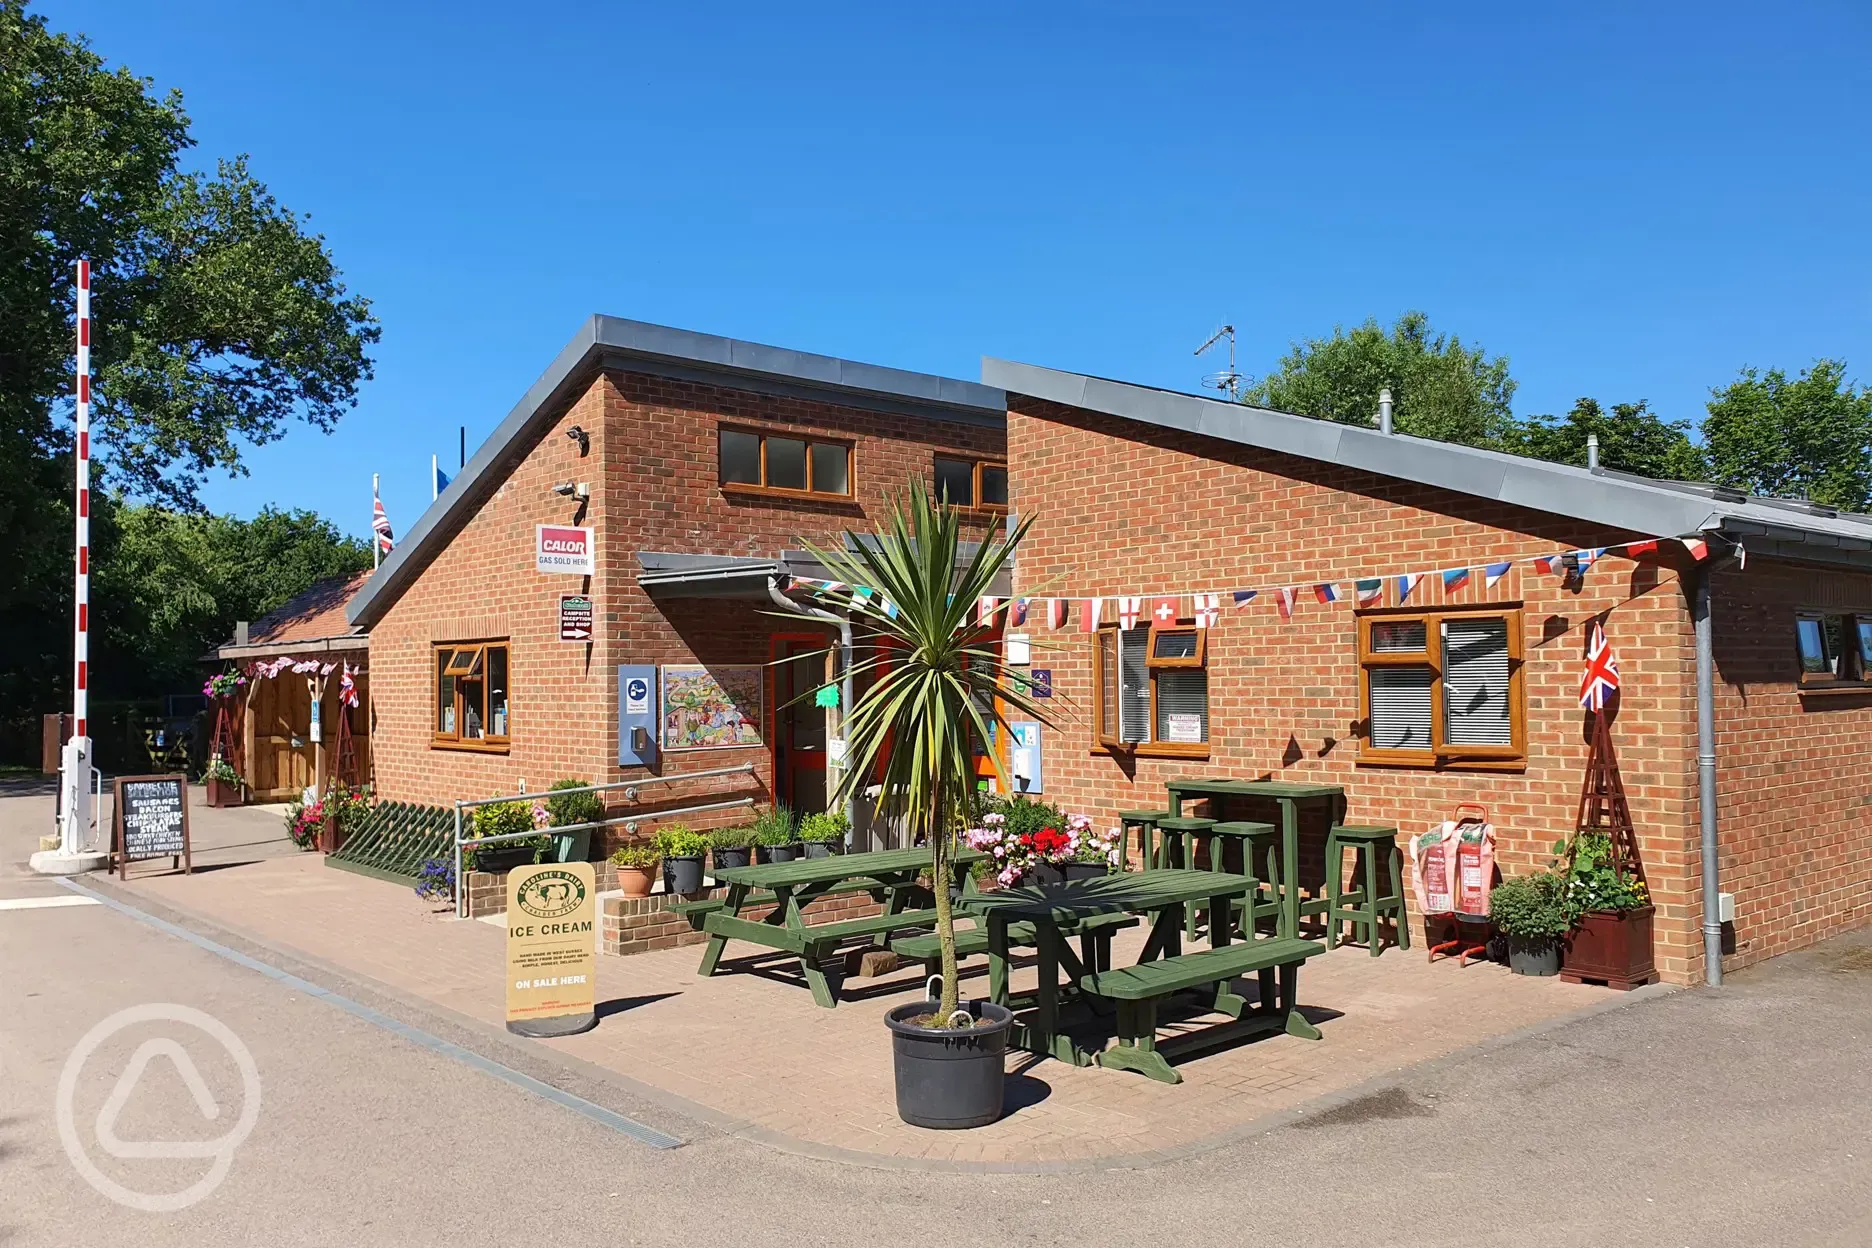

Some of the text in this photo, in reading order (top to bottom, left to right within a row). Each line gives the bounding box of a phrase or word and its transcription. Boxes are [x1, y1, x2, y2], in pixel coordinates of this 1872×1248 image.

[543, 539, 586, 554] CALOR
[538, 556, 589, 566] GAS SOLD HERE
[127, 782, 177, 791] BARBECUE
[127, 788, 178, 798] SELECTION
[132, 798, 179, 807] SAUSAGES
[139, 805, 171, 814] BACON
[140, 825, 169, 833] STEAK
[126, 843, 184, 853] LOCALLY PRODUCED
[520, 872, 584, 895] CAROLINE'S DAIRY
[561, 902, 577, 914] FARM
[510, 921, 592, 938] ICE CREAM
[516, 975, 586, 989] ON SALE HERE
